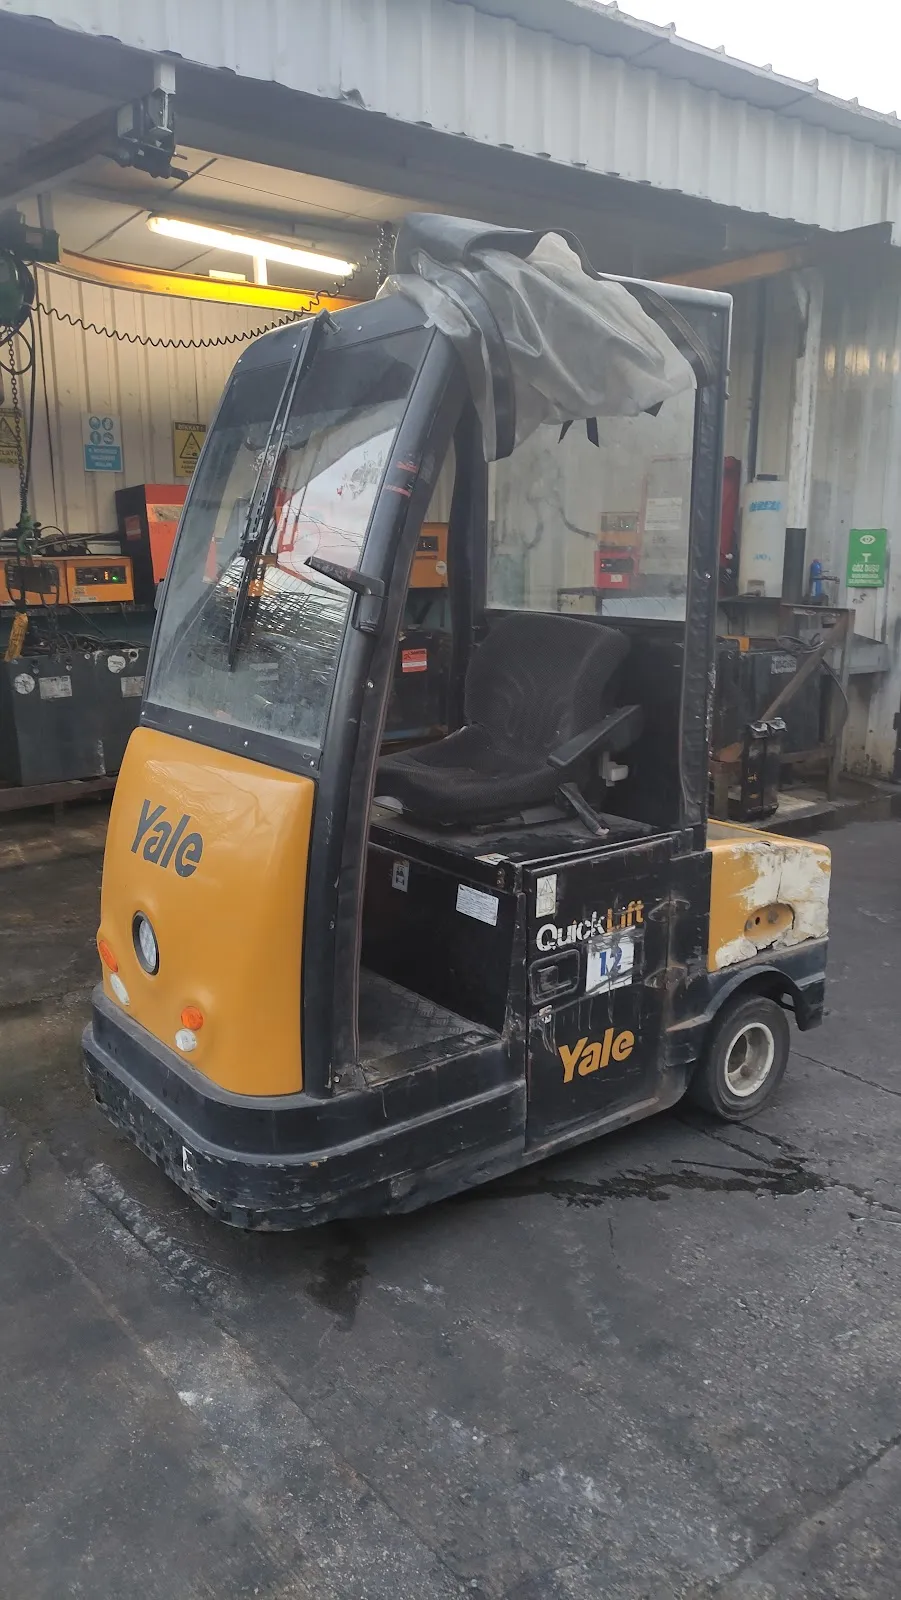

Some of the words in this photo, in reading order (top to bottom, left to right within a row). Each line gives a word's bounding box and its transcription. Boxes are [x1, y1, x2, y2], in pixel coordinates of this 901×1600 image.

[130, 798, 203, 878] Yale
[598, 946, 623, 977] 12
[558, 1027, 635, 1084] Yale
